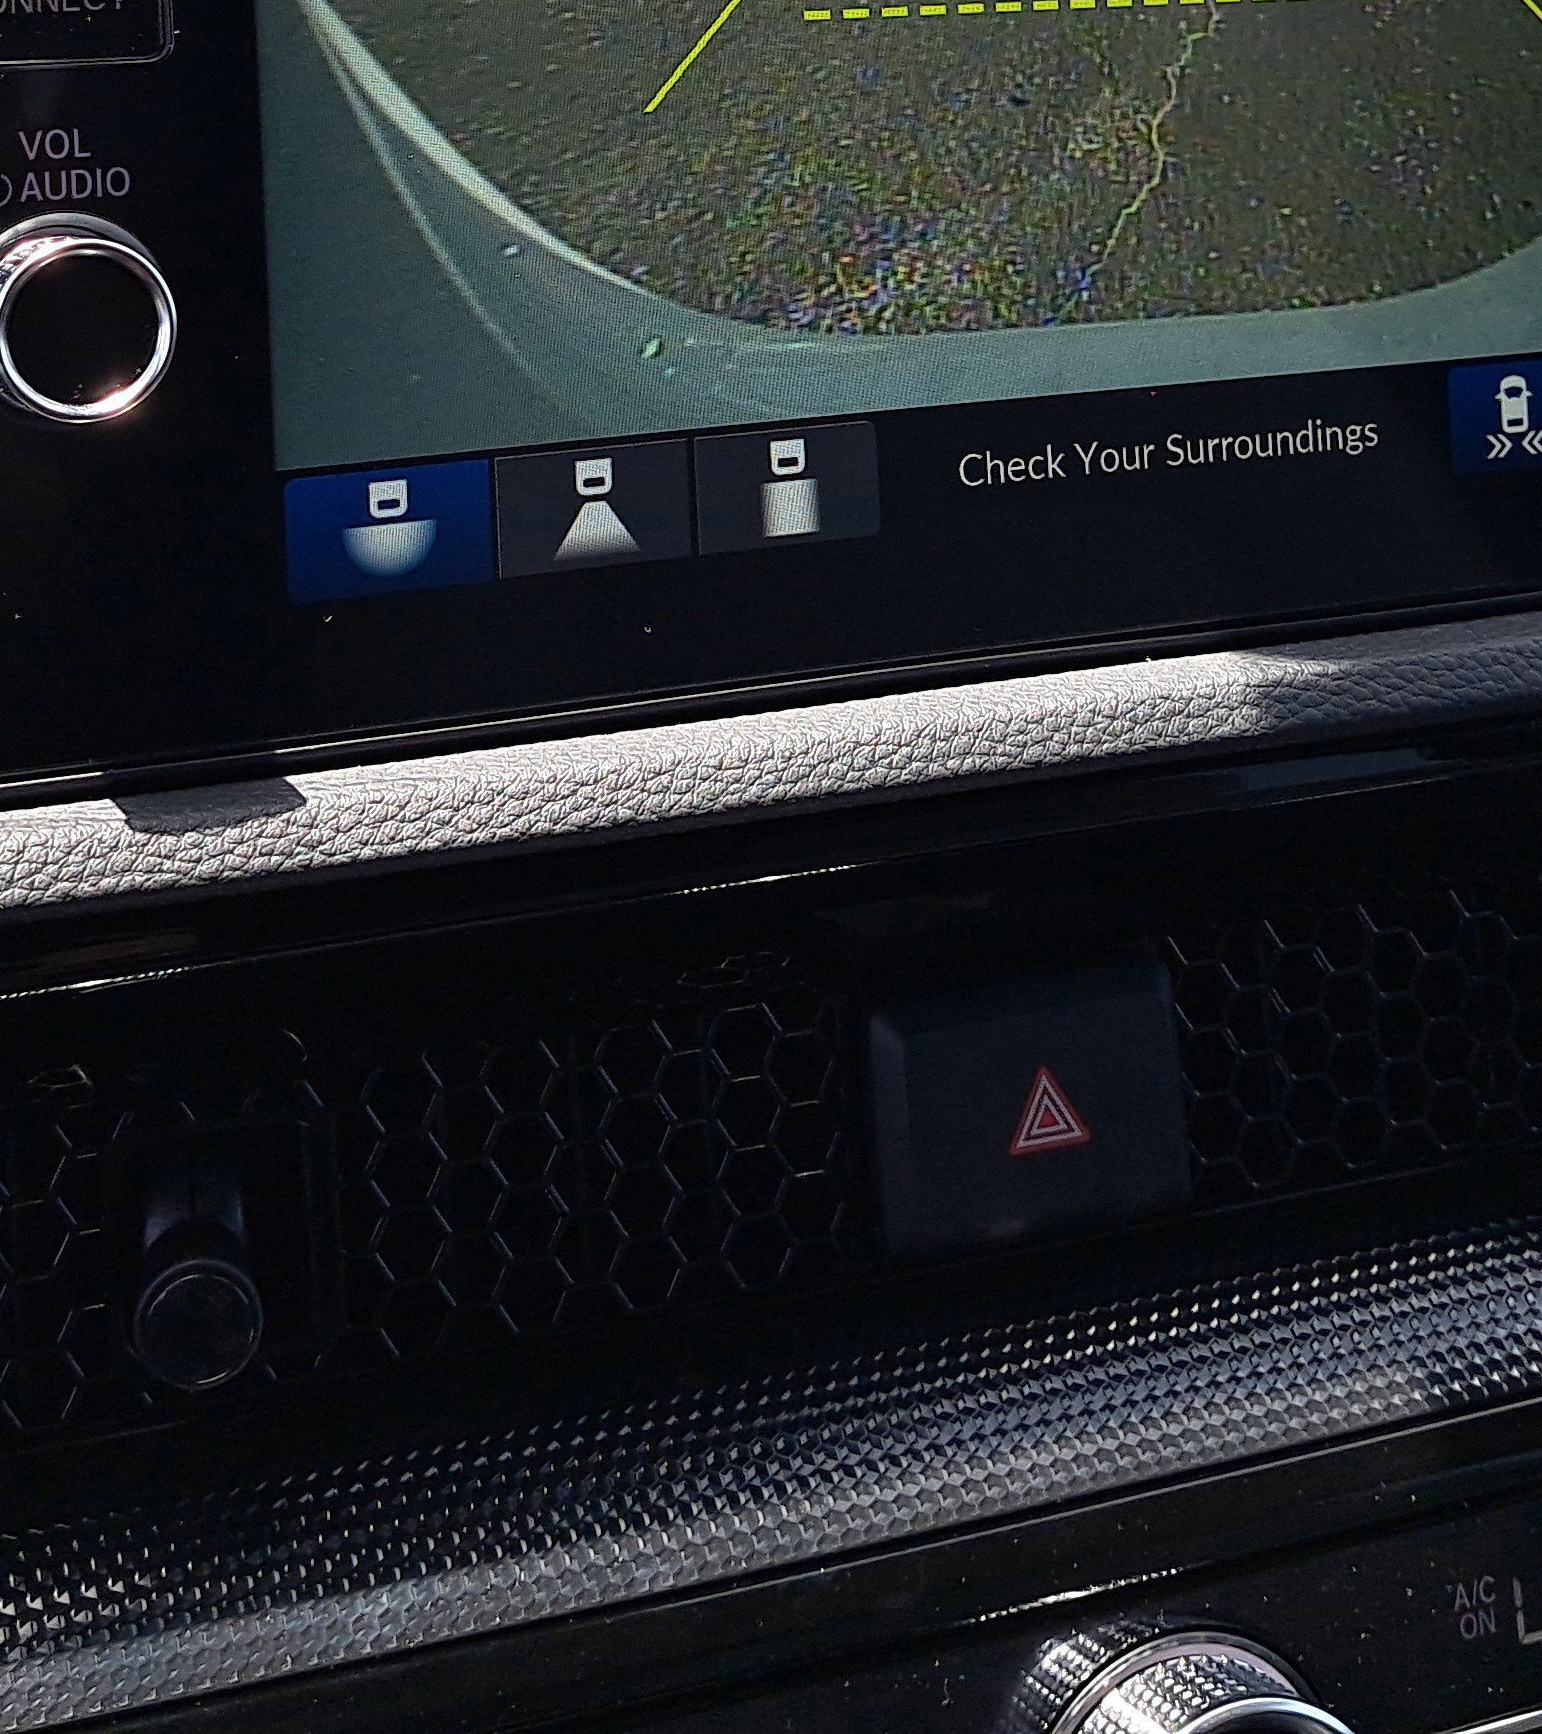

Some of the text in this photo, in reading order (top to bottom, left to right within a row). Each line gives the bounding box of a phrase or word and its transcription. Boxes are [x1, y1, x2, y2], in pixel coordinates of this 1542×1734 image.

[17, 127, 91, 161] VOL
[20, 166, 130, 203] AUDIO
[958, 418, 1379, 488] Check Your Surroundings
[1454, 1574, 1497, 1613] A/C
[1459, 1605, 1497, 1641] ON
